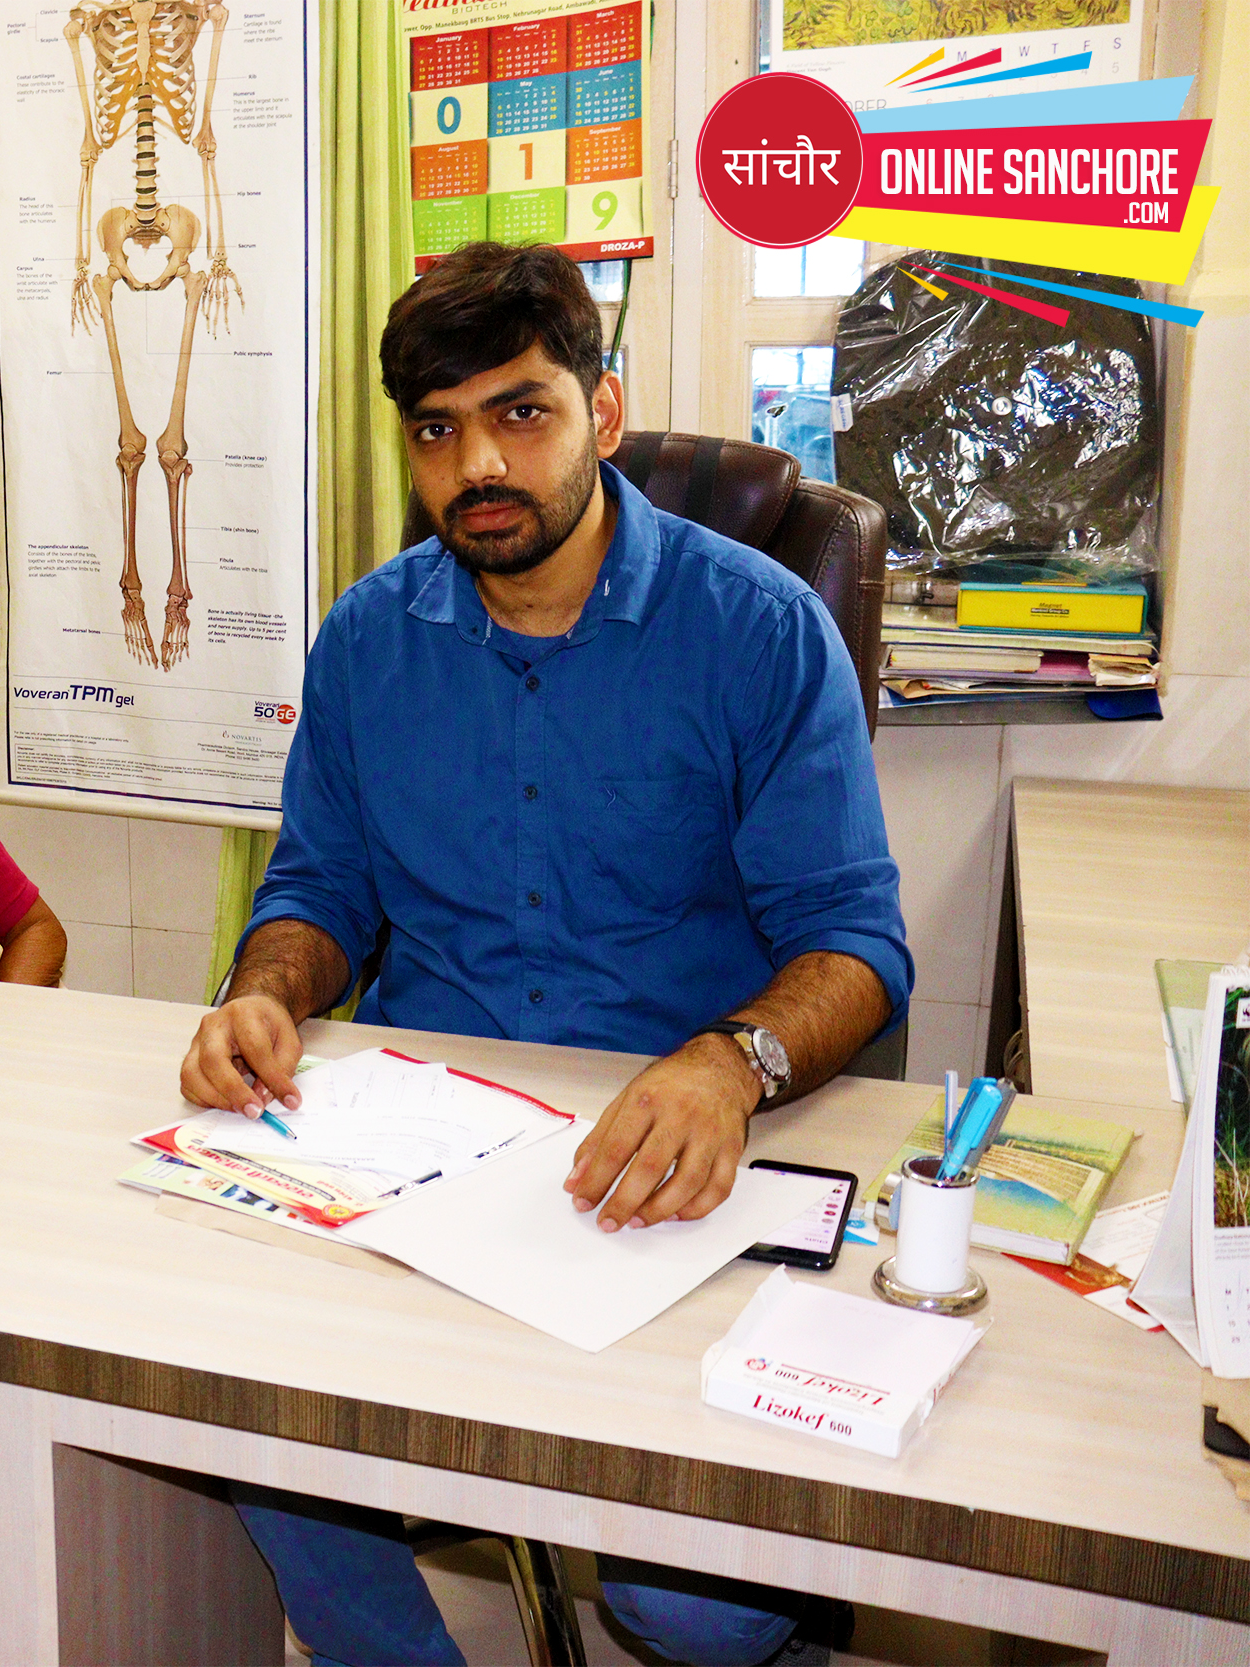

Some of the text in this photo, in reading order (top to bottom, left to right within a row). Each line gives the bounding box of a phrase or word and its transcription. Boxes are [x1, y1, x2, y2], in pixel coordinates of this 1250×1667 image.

[452, 1, 508, 14] BIOTECH
[420, 23, 434, 32] Opp.
[435, 19, 469, 28] Manekbaug
[470, 15, 484, 24] BRTS
[485, 14, 496, 22] Bus
[513, 8, 547, 18] Nehrunagar
[596, 9, 615, 19] March
[956, 37, 1122, 62] M W T F S
[598, 68, 614, 76] June
[1112, 62, 1120, 74] 5
[436, 96, 462, 135] 0
[588, 125, 622, 136] September
[438, 144, 460, 152] August
[518, 142, 534, 180] 1
[510, 192, 540, 200] December
[432, 200, 462, 208] November
[591, 190, 618, 231] 9
[600, 240, 646, 252] DROZA-P
[115, 694, 135, 708] gel
[254, 700, 280, 708] Voveran
[232, 734, 262, 742] NOVARTIS
[774, 1368, 884, 1406] Lizokef 600
[752, 1394, 852, 1436] Lizokef 600
